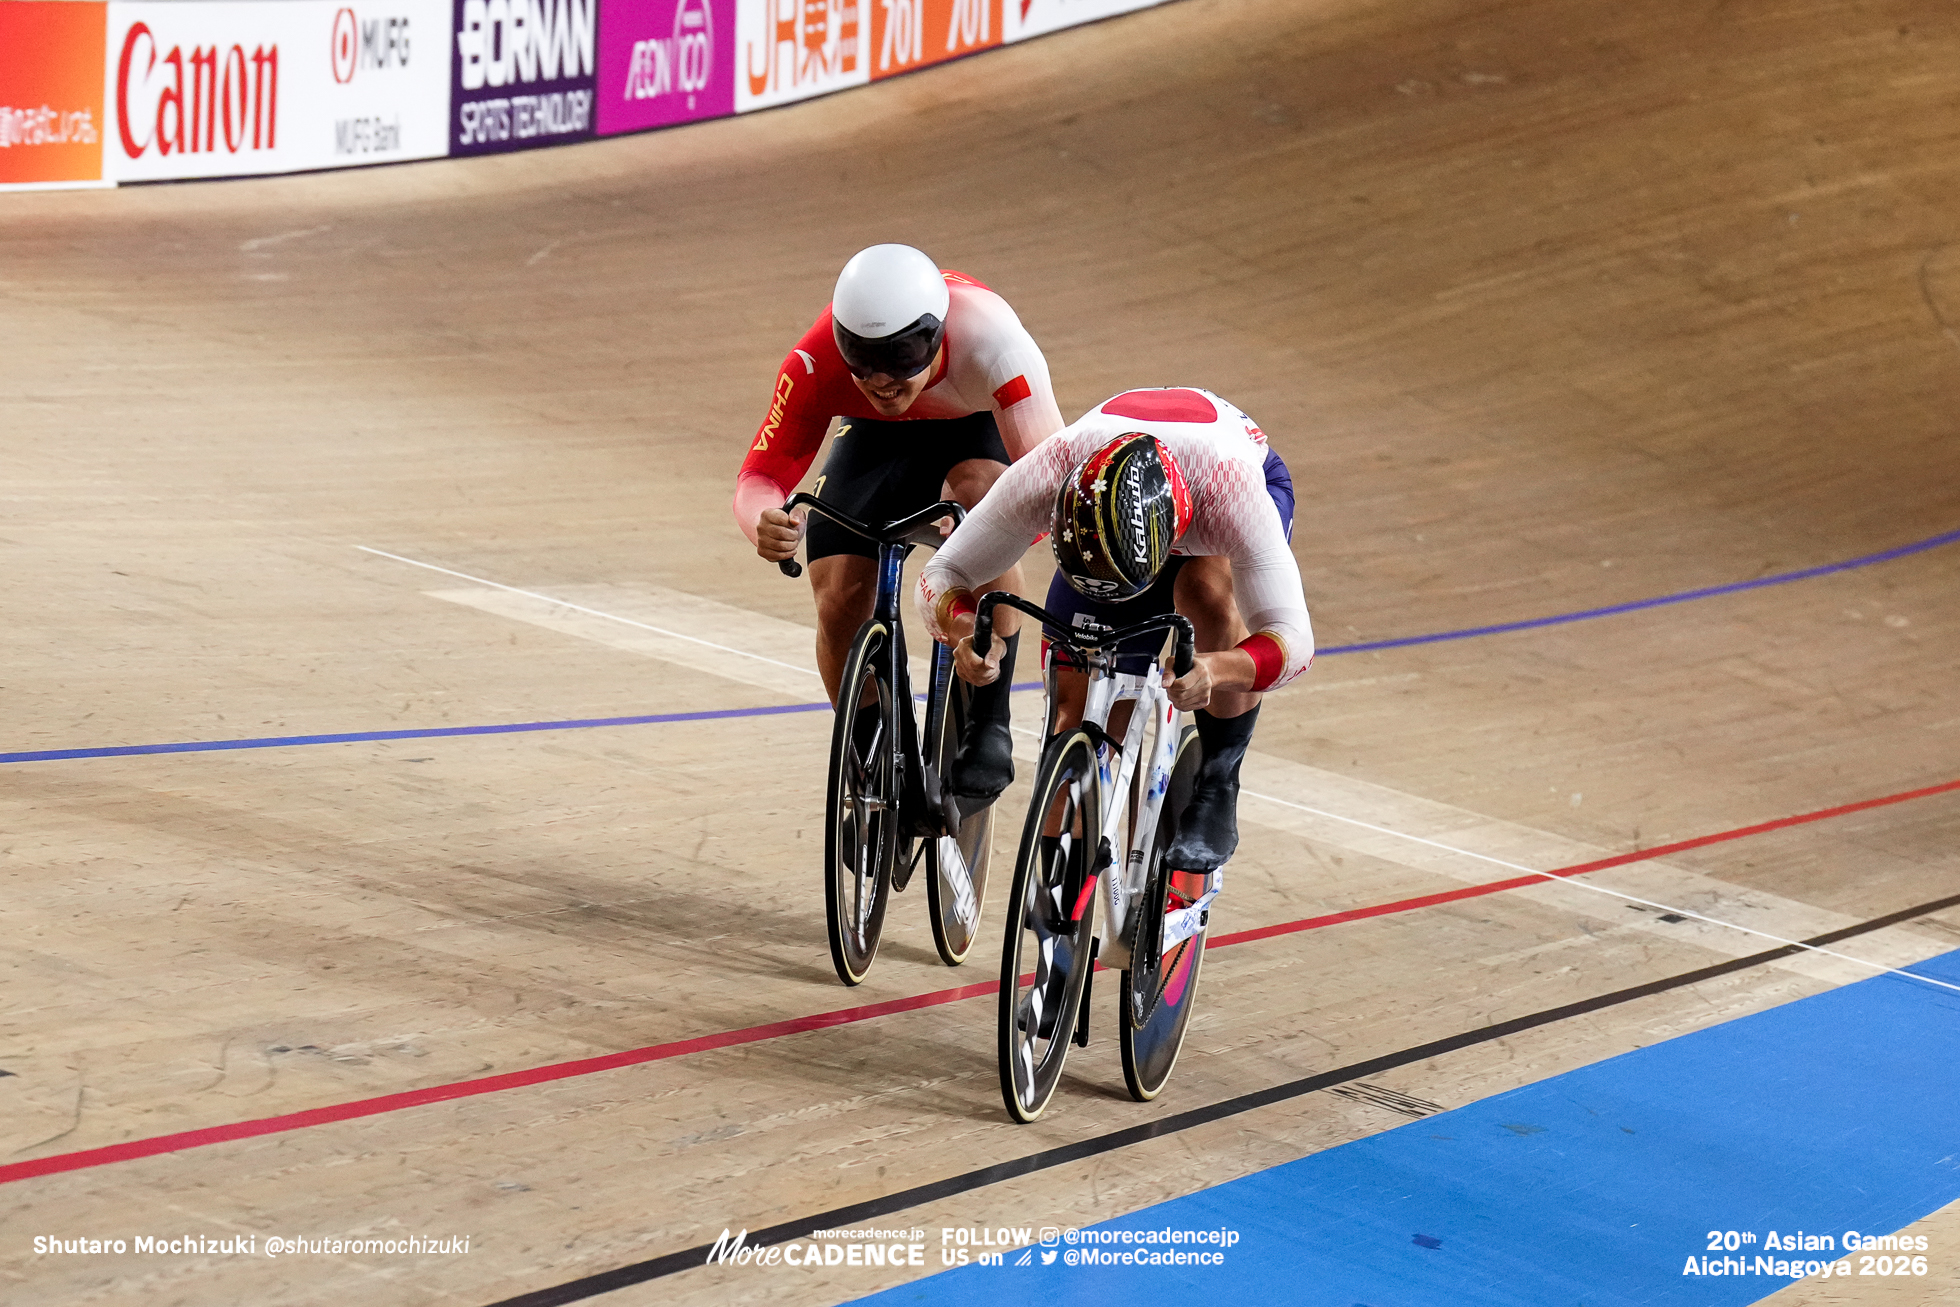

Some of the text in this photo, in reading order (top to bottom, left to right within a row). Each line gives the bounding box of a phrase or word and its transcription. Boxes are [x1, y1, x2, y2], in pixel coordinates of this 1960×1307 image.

[361, 17, 410, 69] MUFG
[116, 20, 278, 159] Canon
[459, 88, 592, 145] SPORTS TECHNOLOGY
[334, 112, 401, 155] MUFG Bank
[753, 372, 794, 451] CHINA
[1127, 465, 1148, 564] Kabuto
